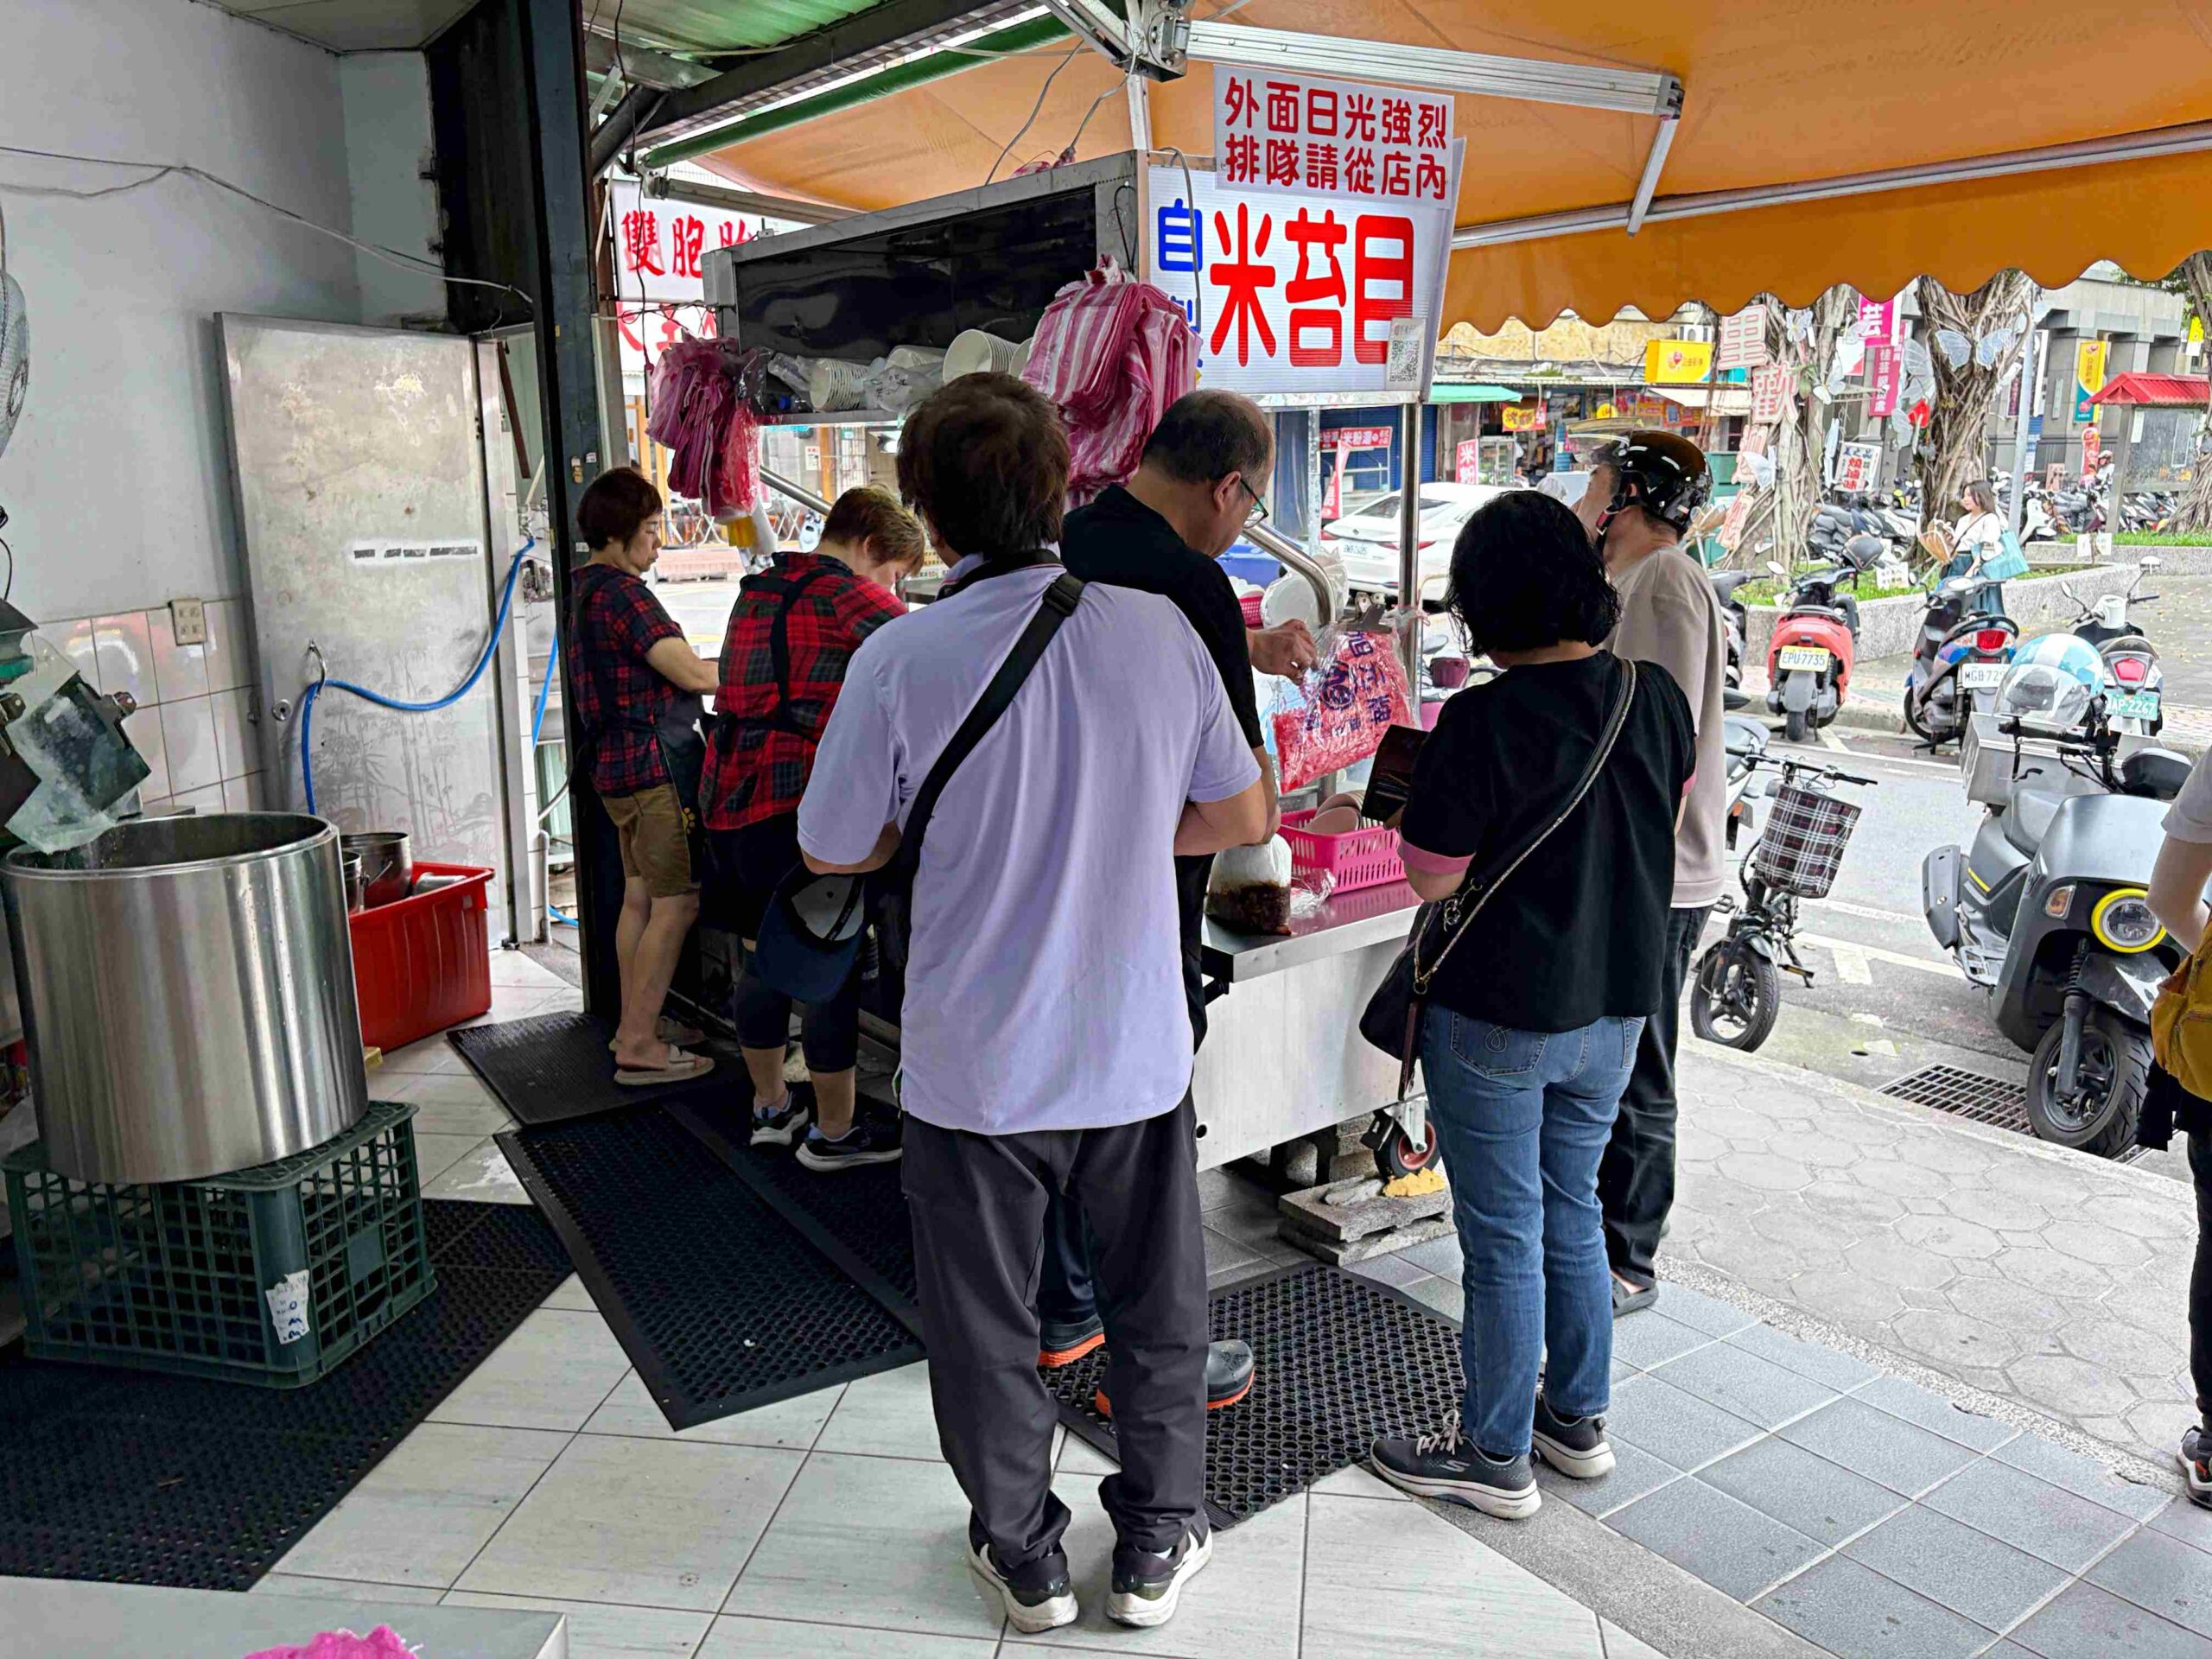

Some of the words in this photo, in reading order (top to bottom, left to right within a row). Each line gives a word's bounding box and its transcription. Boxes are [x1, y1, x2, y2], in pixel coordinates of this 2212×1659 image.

[1224, 76, 1446, 149] 外面日光強烈
[1224, 133, 1446, 200] 排隊請從店內
[1210, 202, 1414, 367] 米苔目
[1782, 652, 1826, 666] EPU-7735
